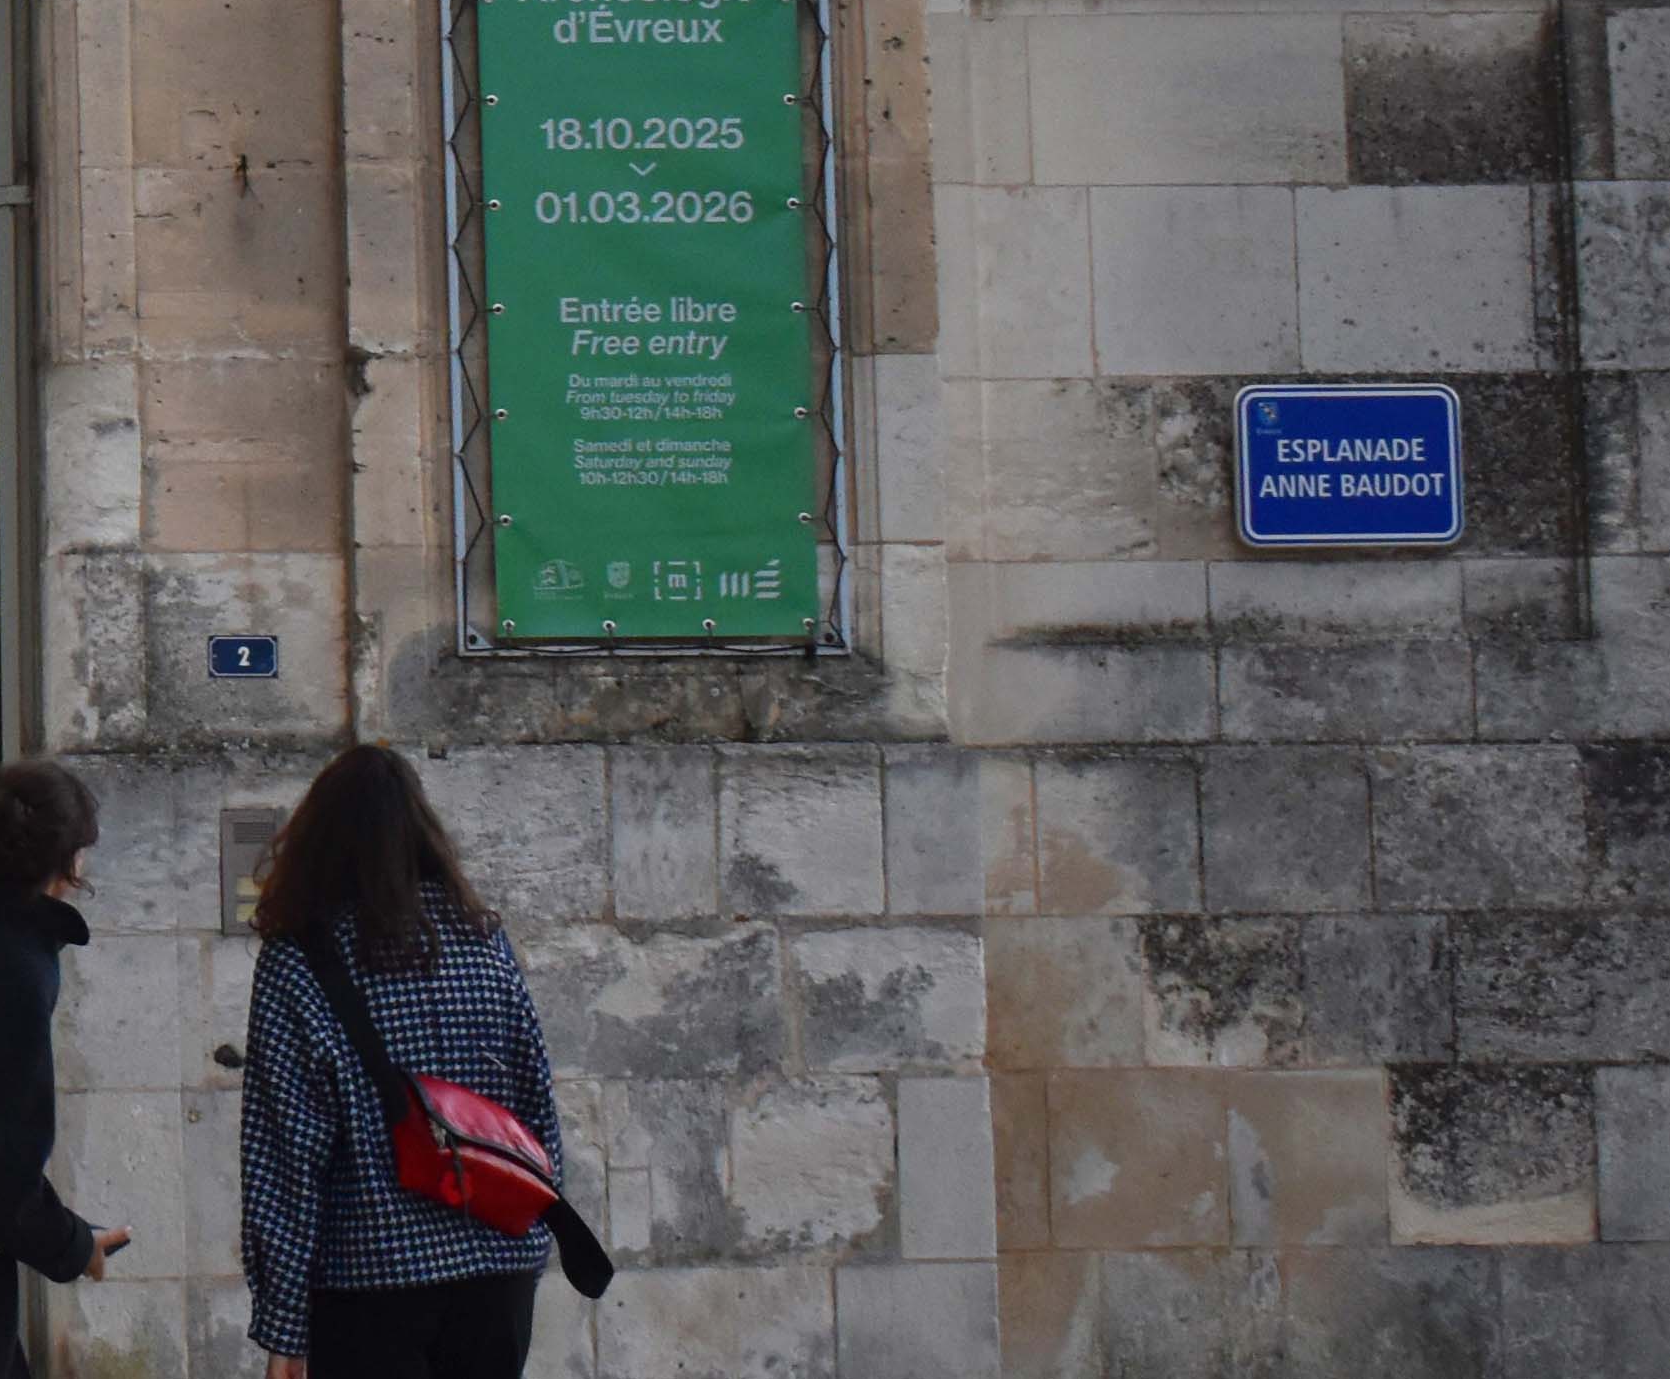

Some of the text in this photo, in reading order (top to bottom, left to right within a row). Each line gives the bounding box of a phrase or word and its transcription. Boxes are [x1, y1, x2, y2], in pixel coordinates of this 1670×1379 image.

[553, 4, 724, 44] d'Évreux
[539, 117, 745, 150] 18.10.2025
[534, 190, 755, 224] 01.03.2026
[559, 296, 738, 323] Entrée libre
[571, 329, 729, 360] Free entry
[569, 373, 733, 388] Du mardi au vendredi
[565, 390, 736, 407] From tuesday to friday
[573, 438, 732, 453] Samedi et dimanche
[1276, 437, 1427, 463] ESPLANADE
[573, 454, 734, 472] Saturday and sunday
[1258, 472, 1445, 498] ANNE BAUDOT
[237, 645, 251, 667] 2
